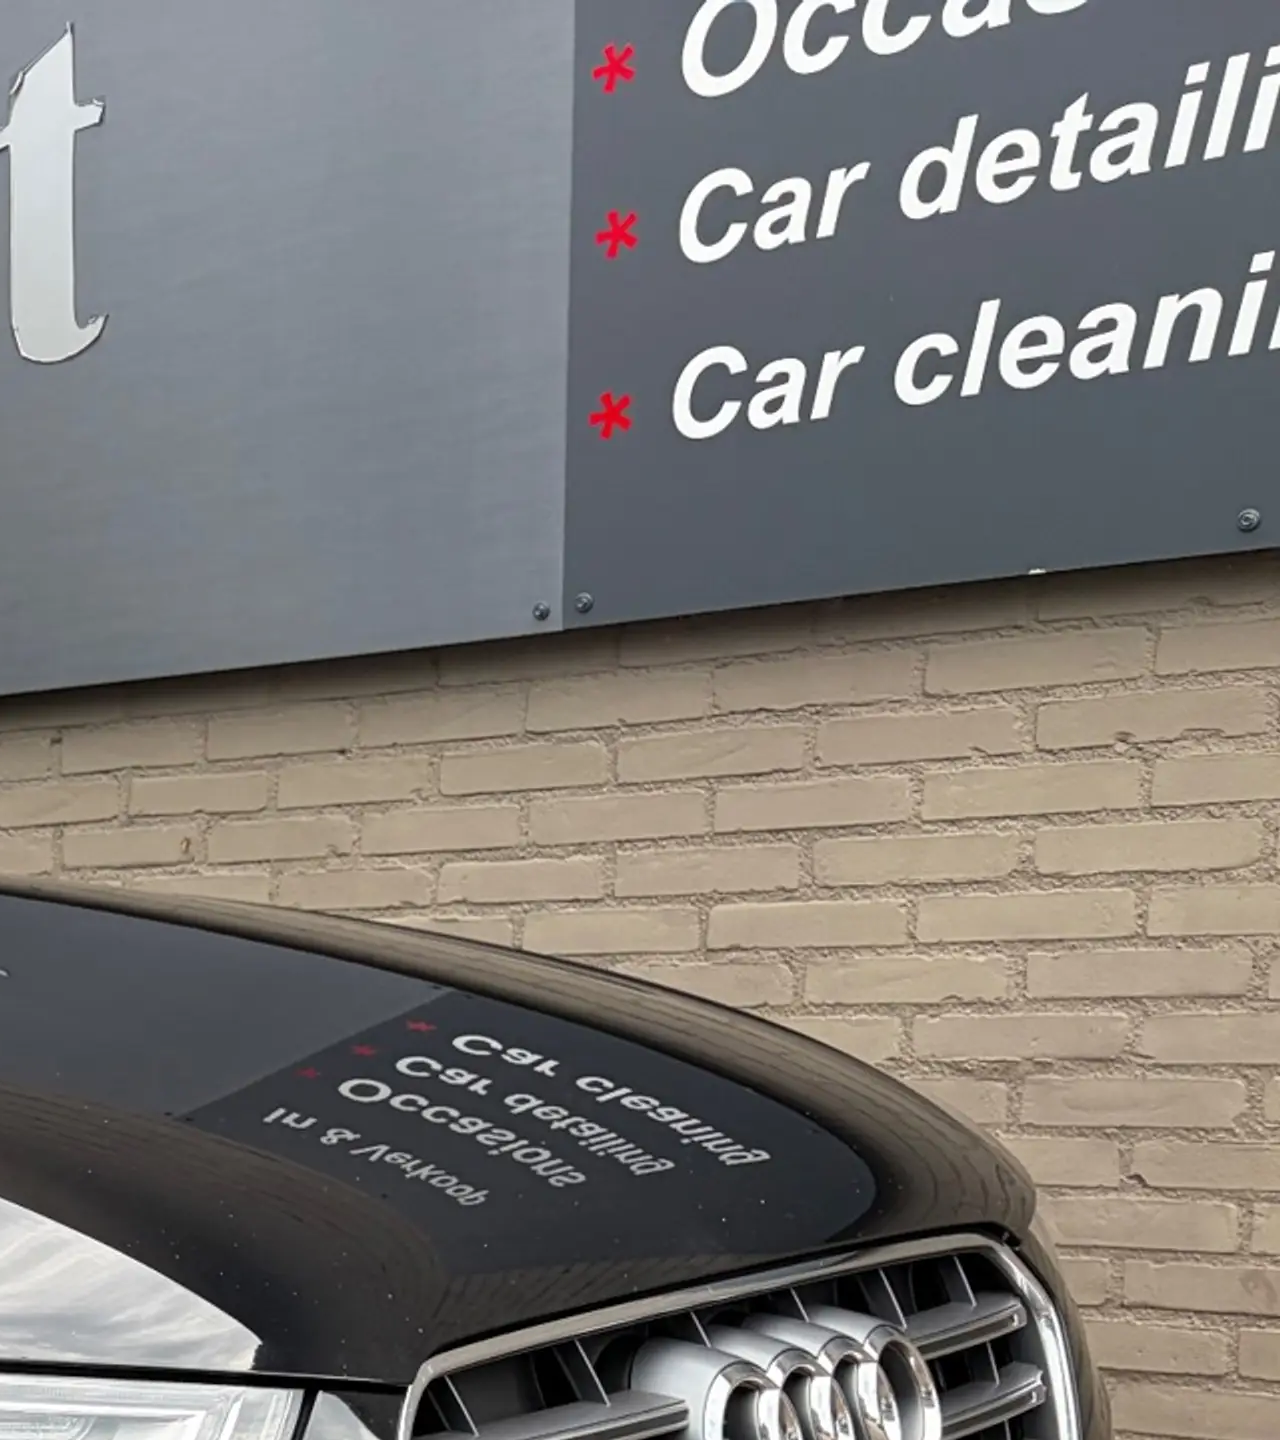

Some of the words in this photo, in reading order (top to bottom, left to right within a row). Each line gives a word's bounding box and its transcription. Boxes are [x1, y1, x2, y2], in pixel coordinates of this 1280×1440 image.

[678, 160, 870, 263] Car
[672, 345, 864, 440] Car
[893, 250, 1280, 405] cleani
